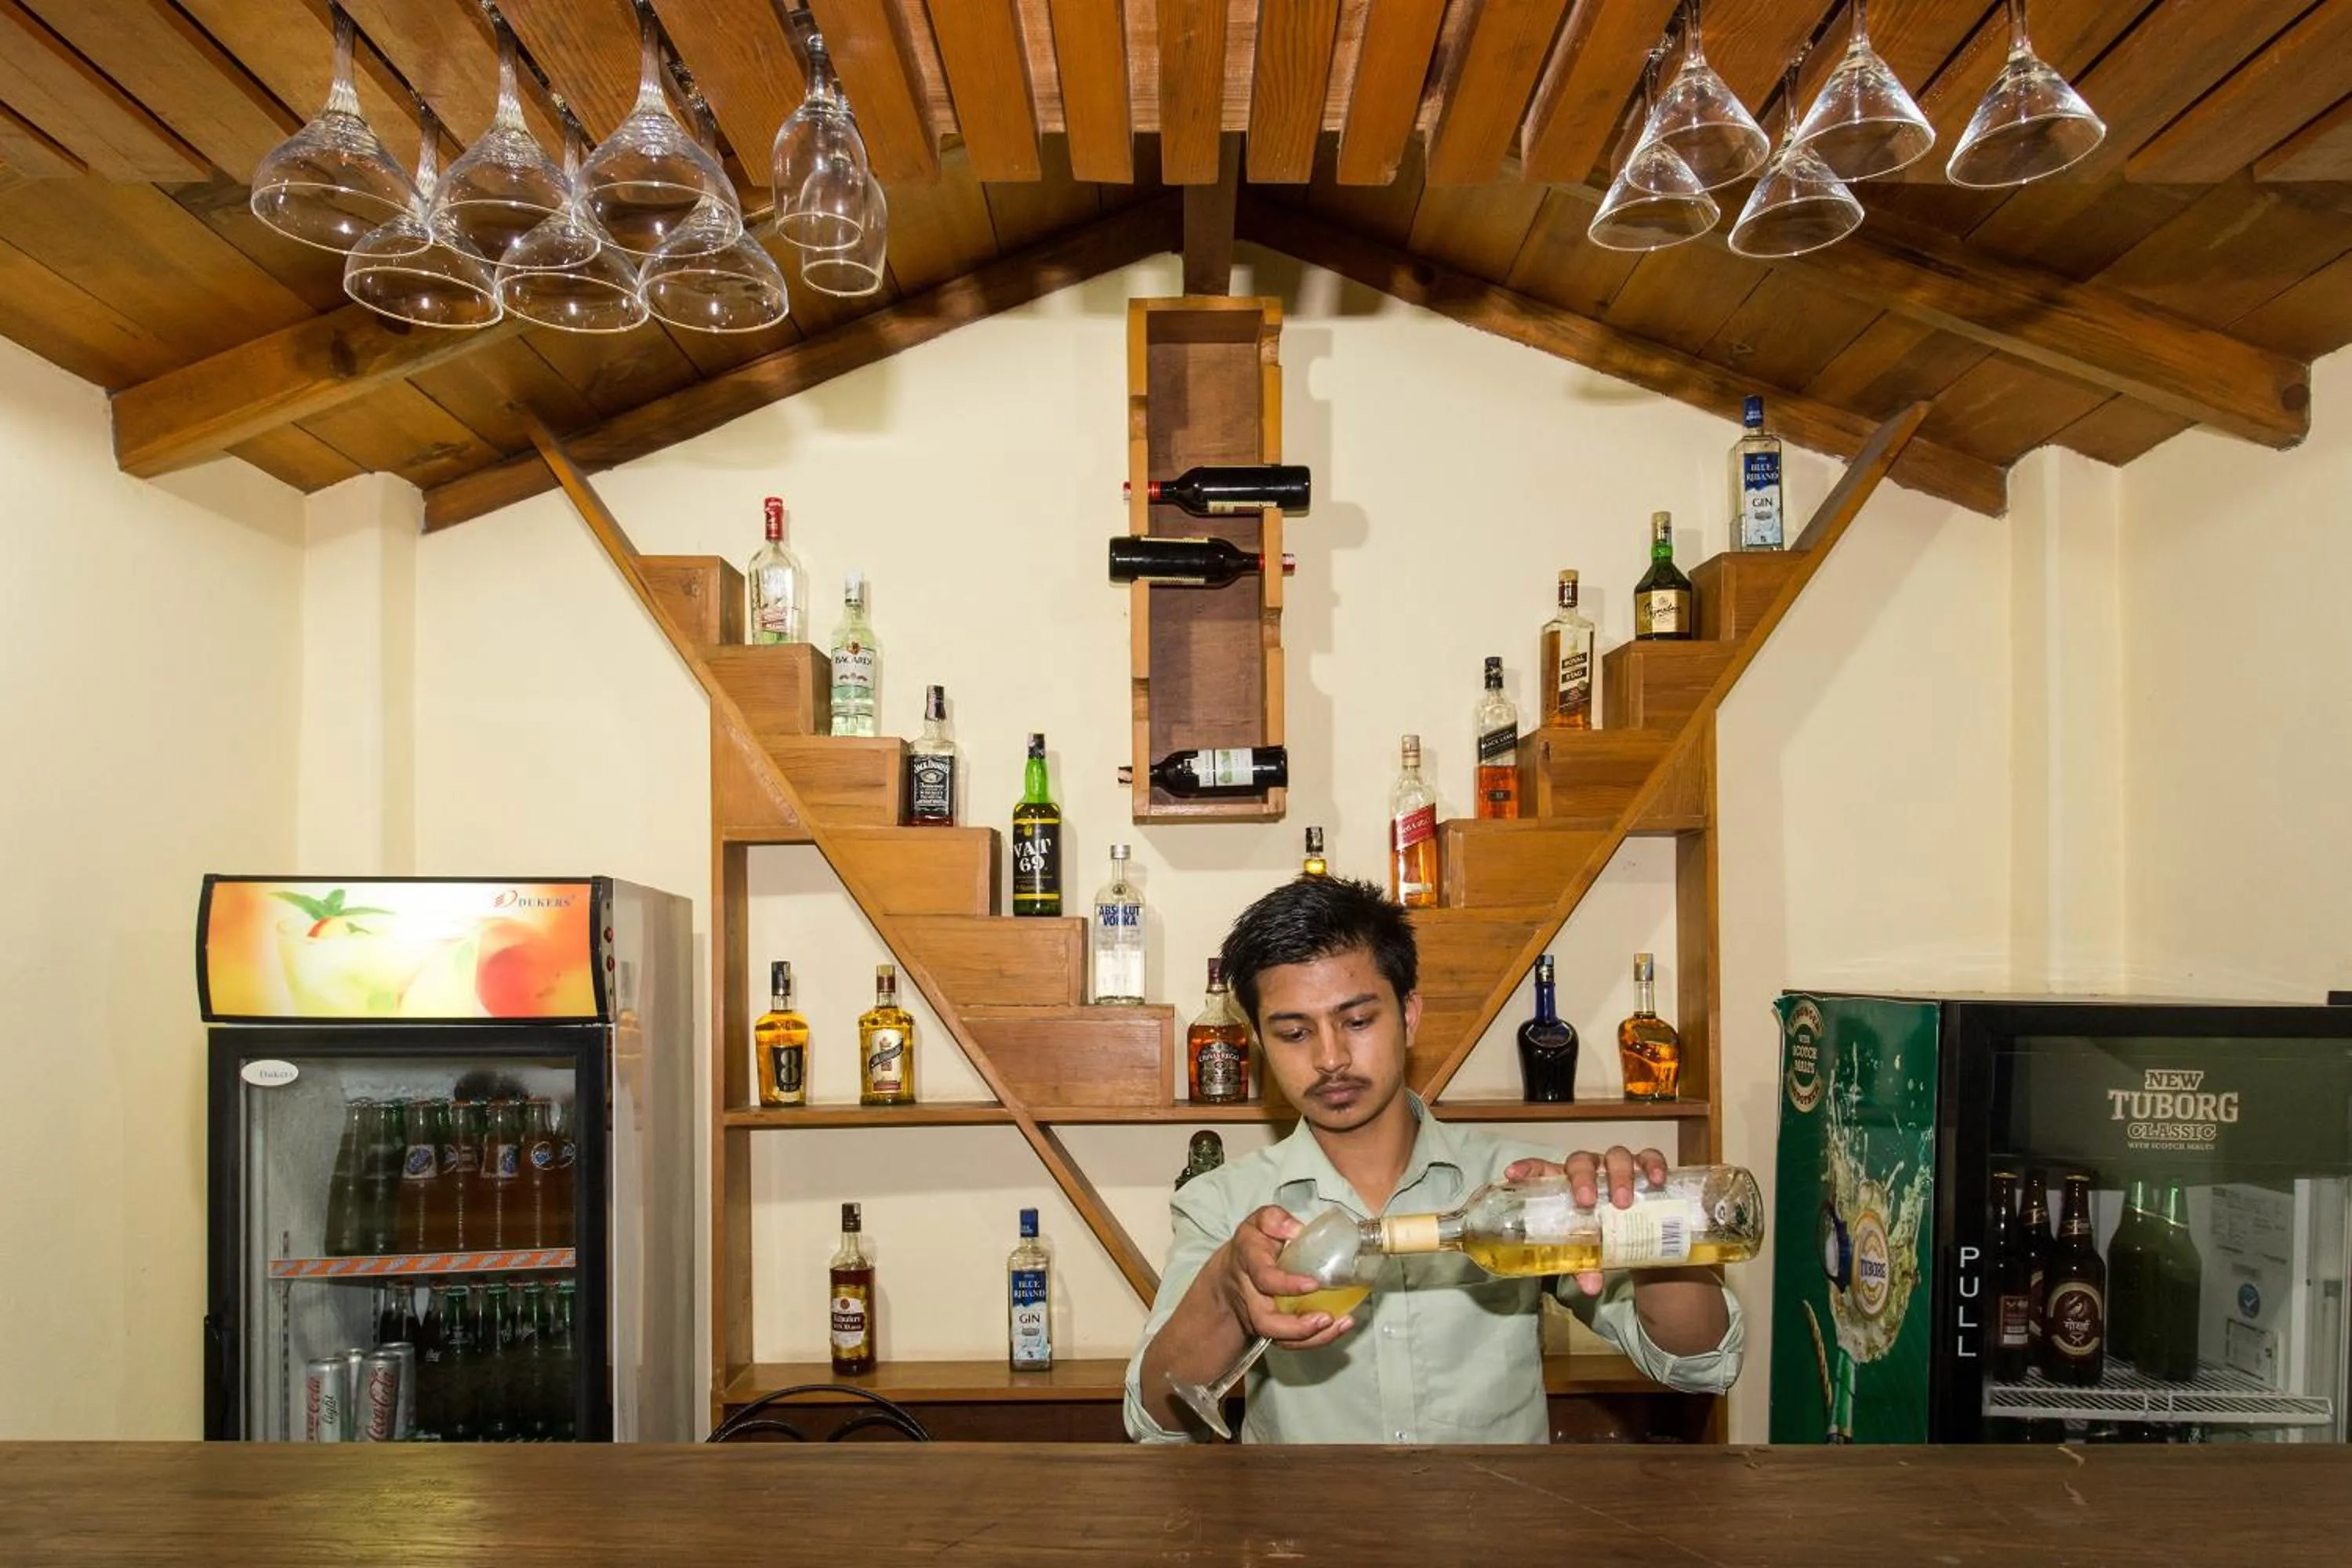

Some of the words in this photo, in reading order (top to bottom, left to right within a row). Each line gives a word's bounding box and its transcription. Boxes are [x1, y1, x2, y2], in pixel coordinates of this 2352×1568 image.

[1752, 497, 1773, 507] GIN
[835, 655, 872, 665] BACARDI
[1563, 655, 1585, 666] ROYAL
[1014, 837, 1051, 858] VAT
[1019, 855, 1045, 872] 69
[2146, 1070, 2204, 1090] NEW
[2107, 1089, 2239, 1122] TUBORG
[2128, 1123, 2216, 1140] CLASSIC
[1860, 1258, 1886, 1279] TUBORG
[1958, 1246, 1980, 1357] PULL
[1018, 1313, 1040, 1324] GIN
